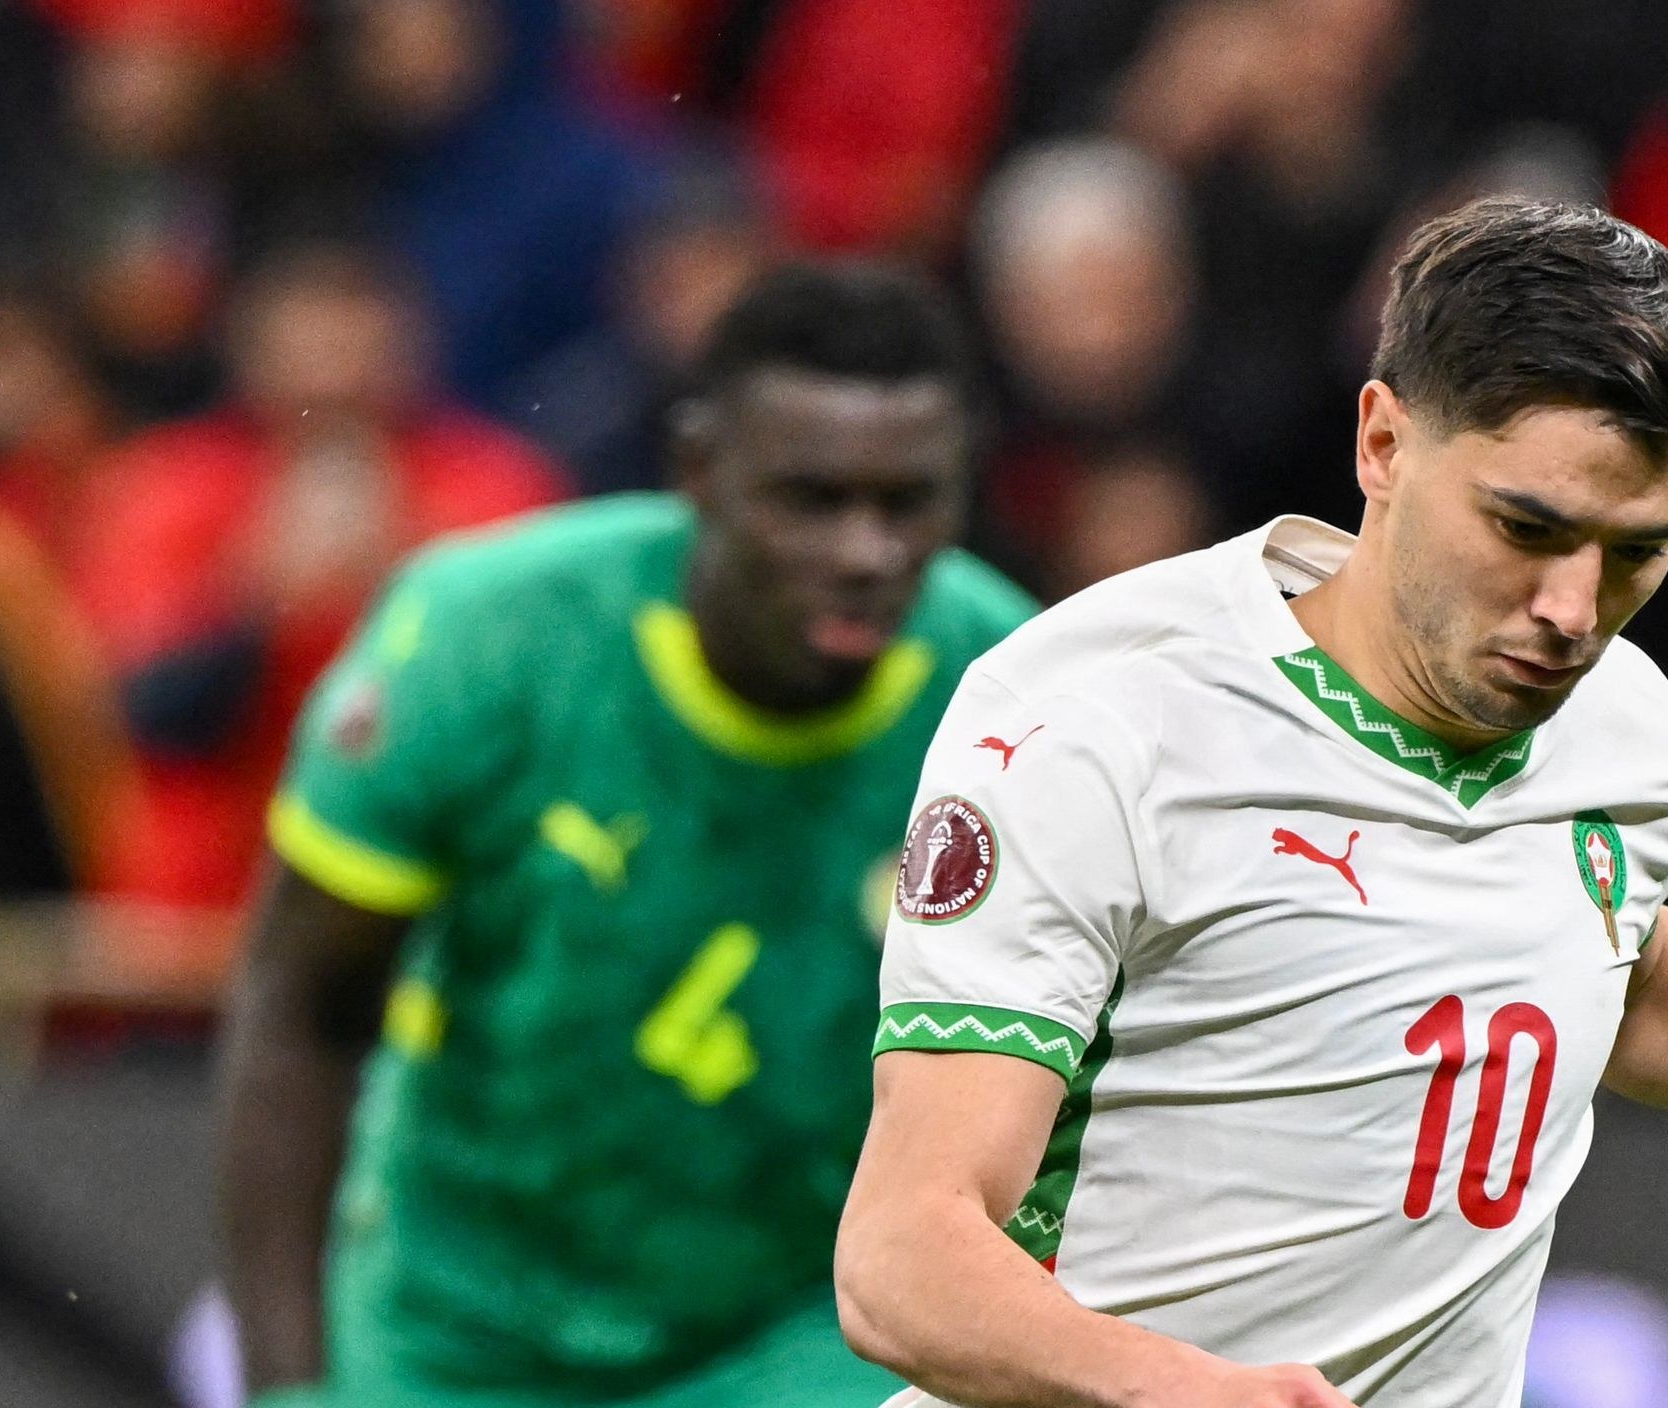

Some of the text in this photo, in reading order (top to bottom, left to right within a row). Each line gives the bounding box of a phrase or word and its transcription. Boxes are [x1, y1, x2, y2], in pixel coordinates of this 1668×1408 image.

[977, 834, 990, 865] CUP
[973, 868, 988, 888] OF
[916, 887, 977, 915] NATIONS
[636, 924, 759, 1104] 4
[1404, 994, 1558, 1229] 10
